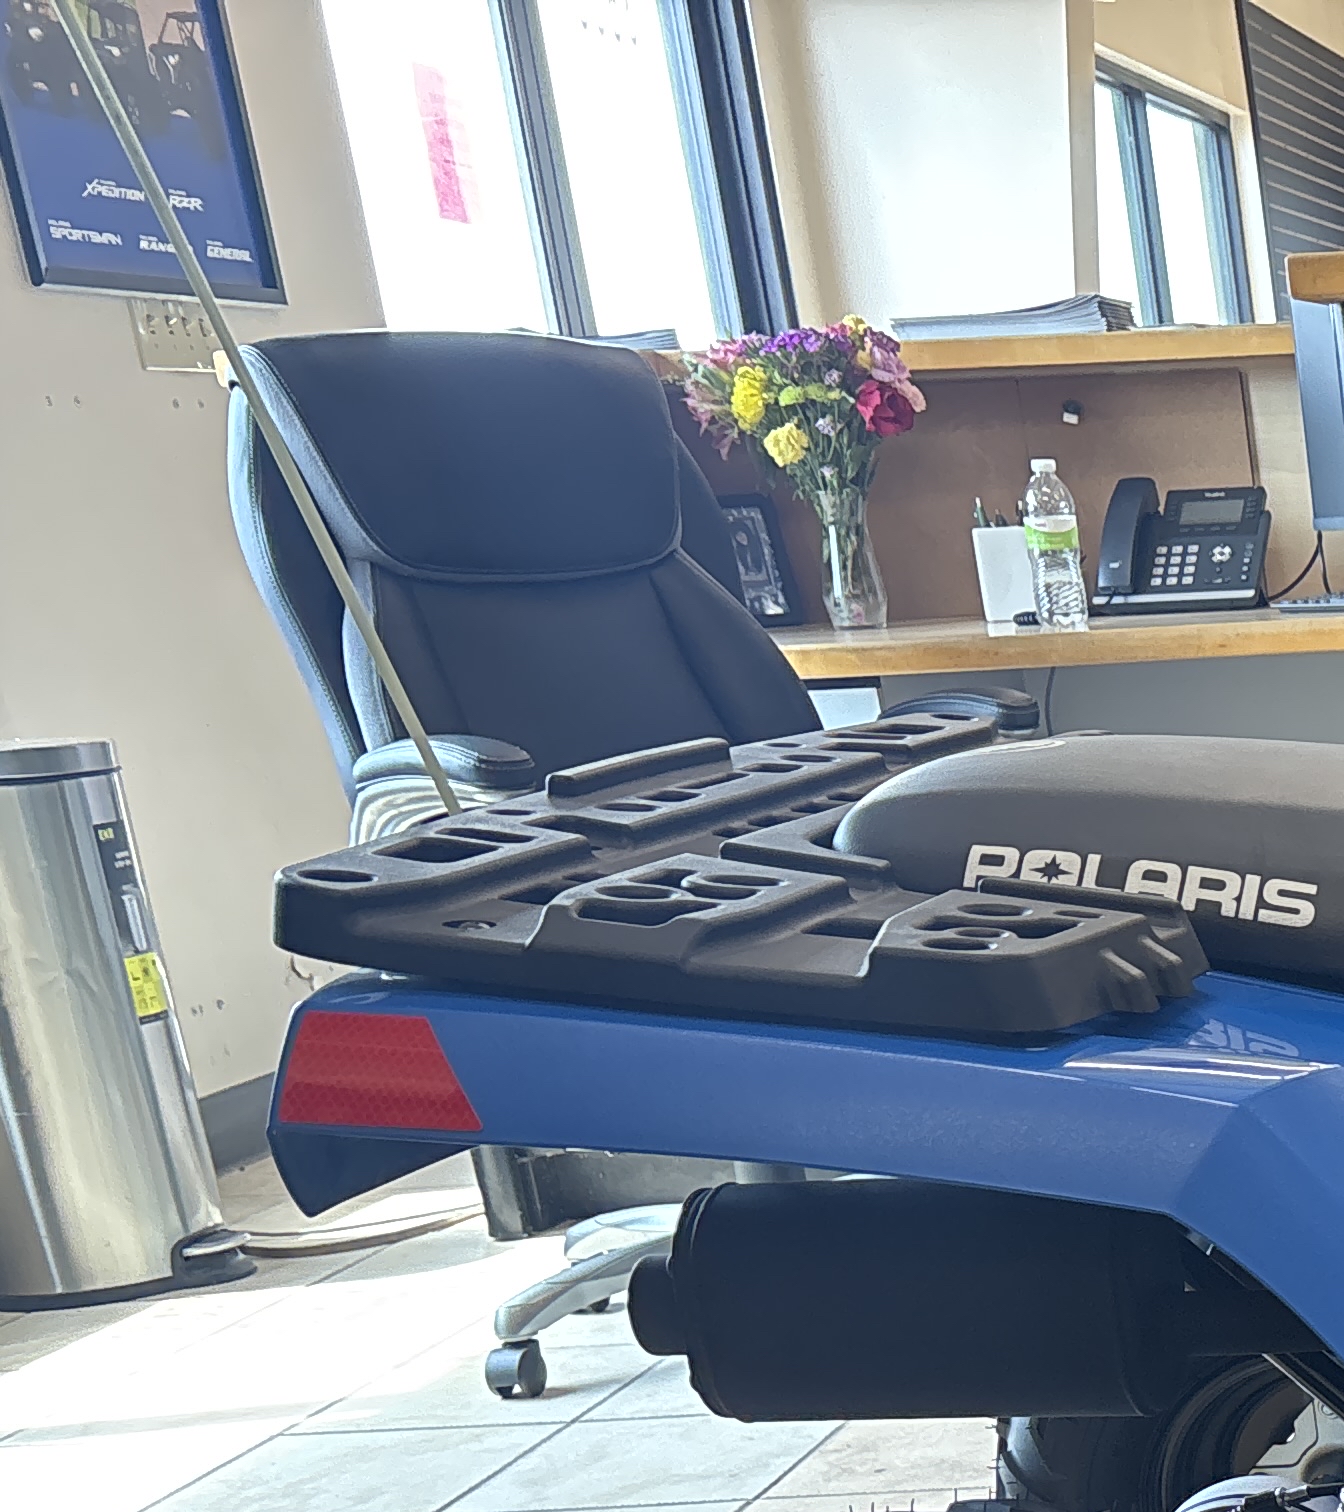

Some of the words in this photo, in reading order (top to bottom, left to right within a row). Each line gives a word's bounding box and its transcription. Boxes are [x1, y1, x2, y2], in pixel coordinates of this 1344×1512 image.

[49, 225, 123, 246] SPORTSMAN
[206, 245, 254, 263] GENERAL
[962, 844, 1319, 928] POLARIS
